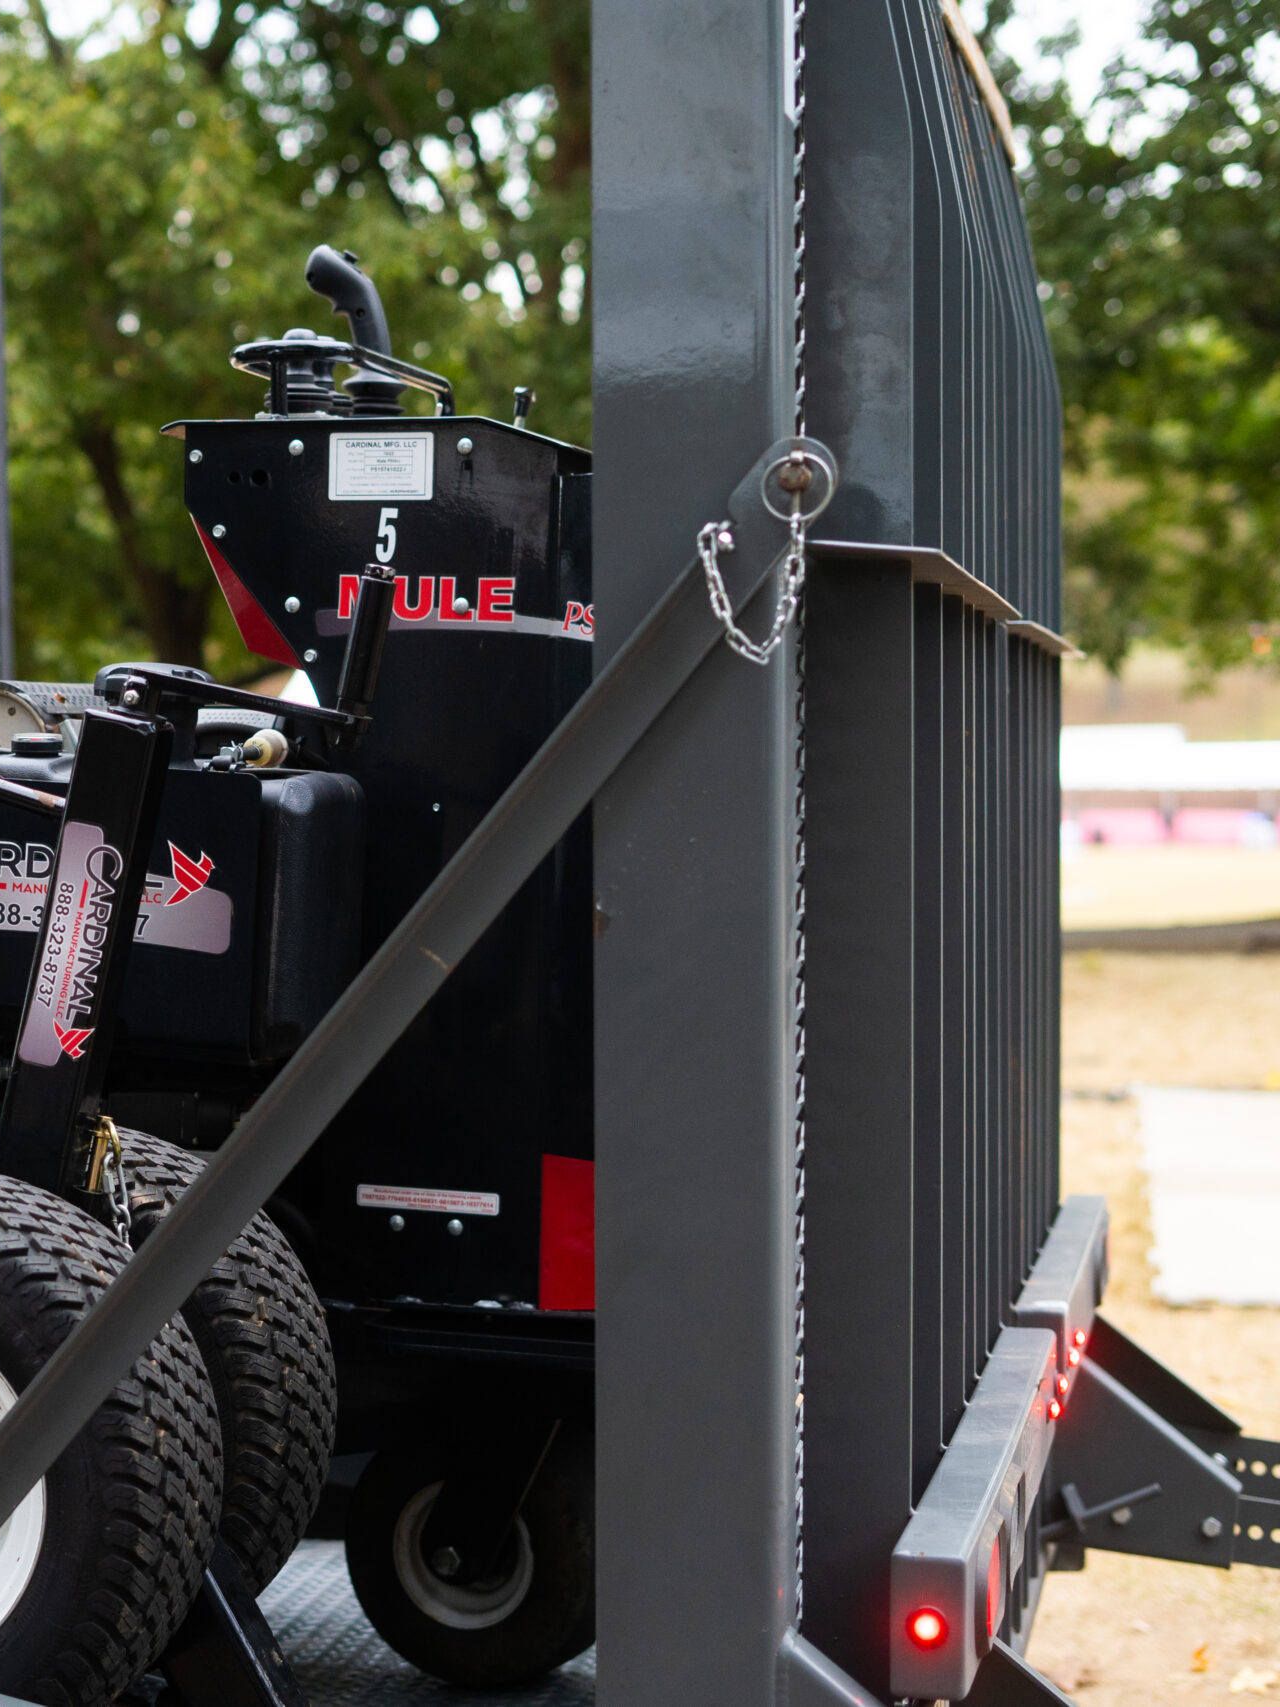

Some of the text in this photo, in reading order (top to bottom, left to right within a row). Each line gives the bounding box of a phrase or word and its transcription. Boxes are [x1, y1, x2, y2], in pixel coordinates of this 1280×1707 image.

[345, 441, 382, 449] CARDINAL
[383, 441, 402, 449] MFG.
[375, 507, 399, 564] 5
[36, 882, 75, 1009] 888-323-8737
[54, 911, 83, 1019] MANUFACTURING LLC
[65, 844, 123, 1022] CARDINAL
